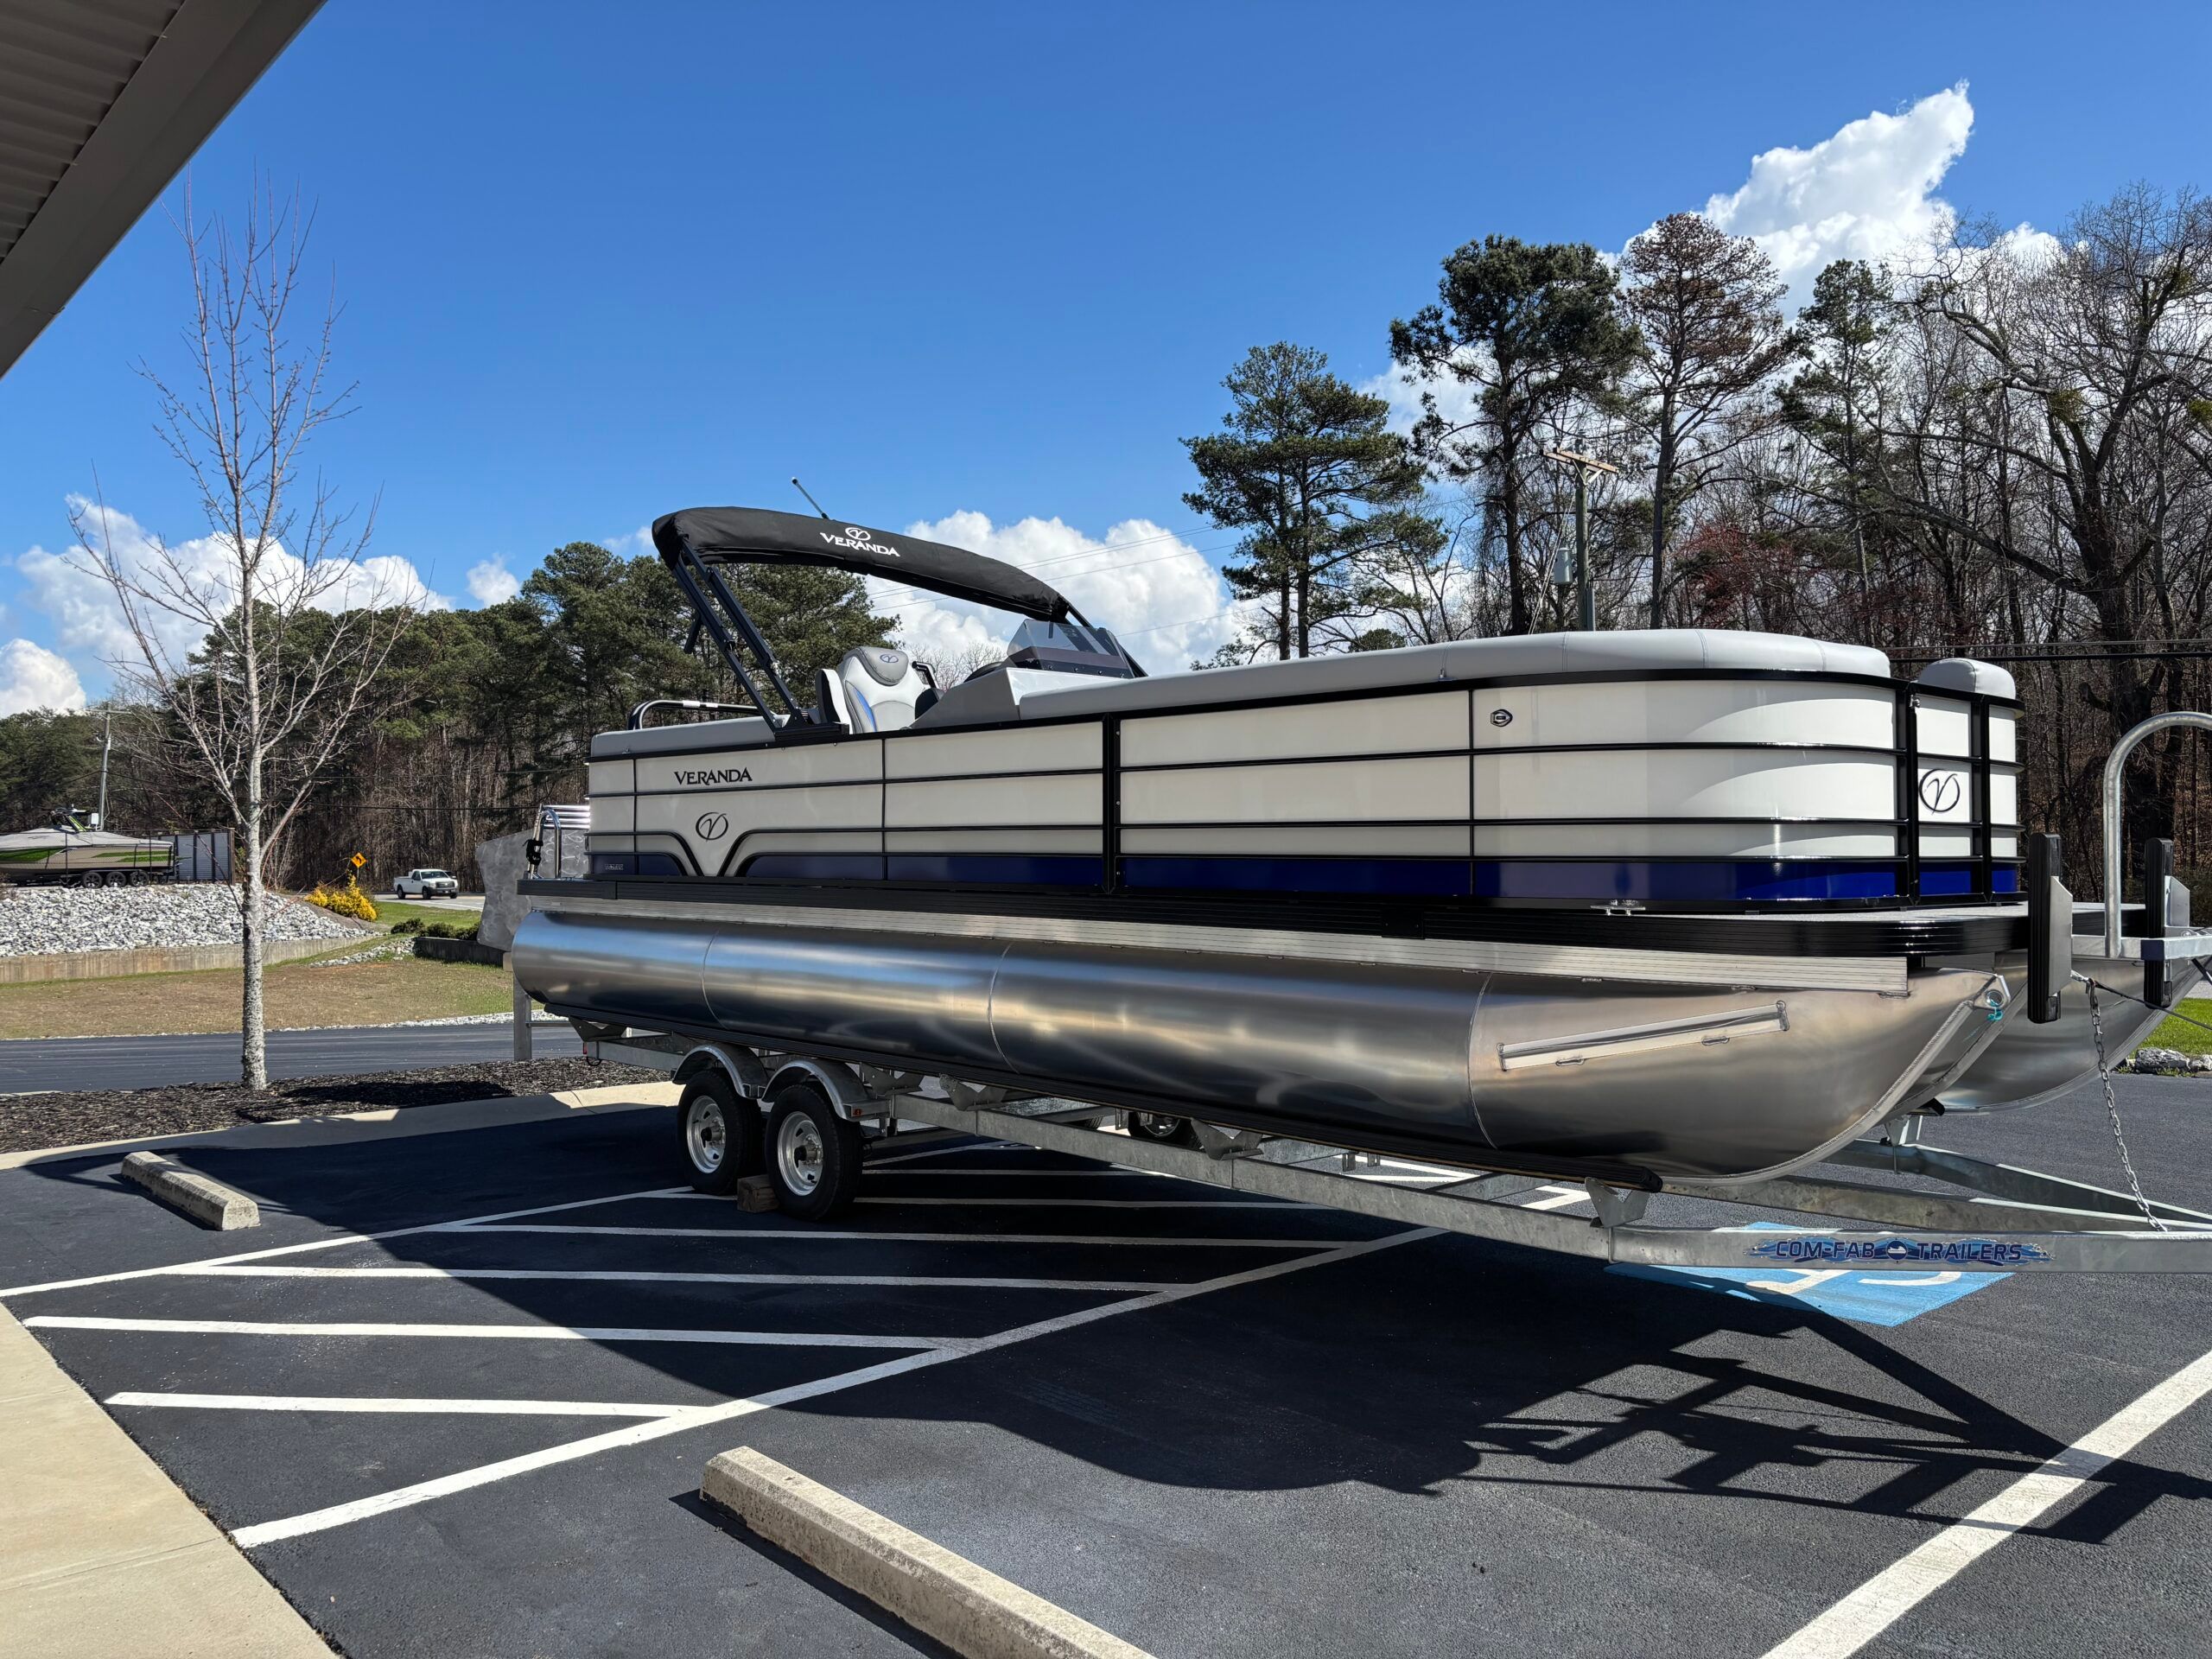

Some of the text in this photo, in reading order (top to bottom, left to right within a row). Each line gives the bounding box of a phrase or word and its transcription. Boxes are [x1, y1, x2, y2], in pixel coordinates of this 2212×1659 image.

[820, 532, 900, 557] VERANDA
[674, 767, 753, 785] VERANDA
[1775, 1241, 2023, 1261] COM-FAB TRAILERS
